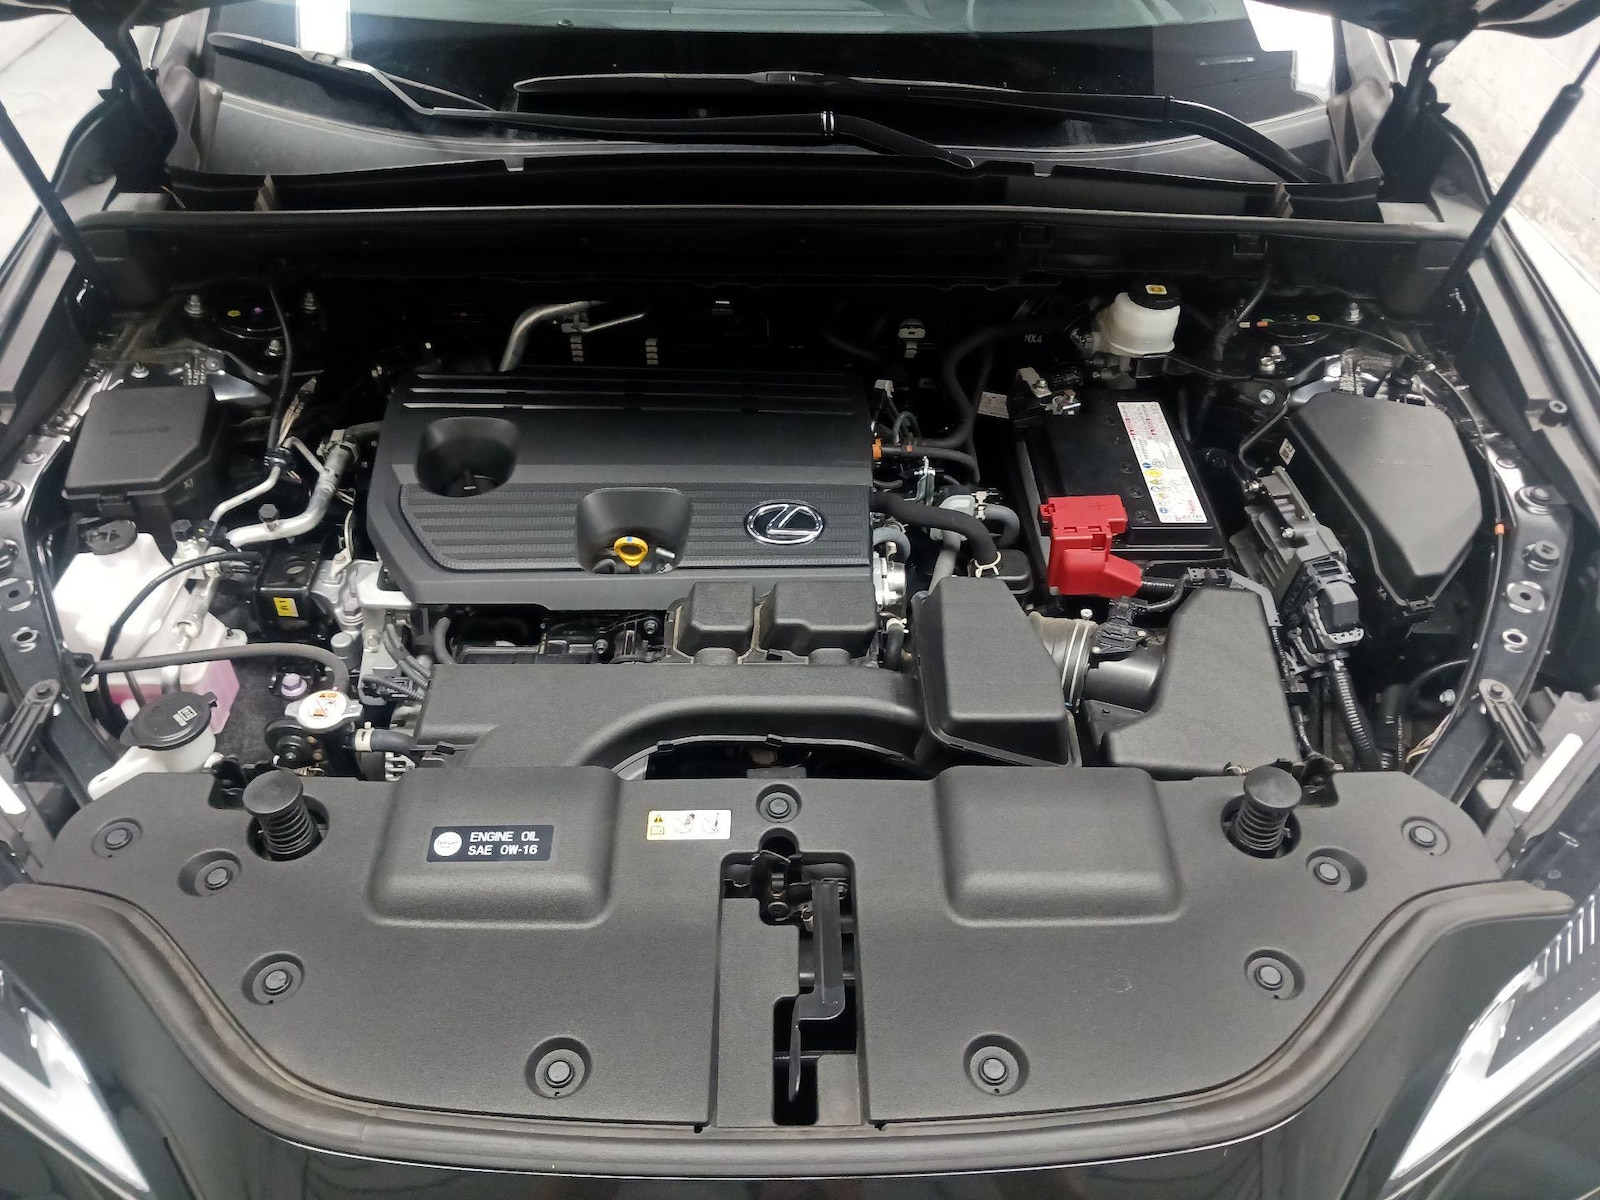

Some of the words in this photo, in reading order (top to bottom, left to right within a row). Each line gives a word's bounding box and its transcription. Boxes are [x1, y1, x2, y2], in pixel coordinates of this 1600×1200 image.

[469, 831, 515, 842] ENGINE
[521, 831, 540, 841] OIL
[467, 844, 494, 856] SAE
[500, 844, 539, 855] 0W-16
